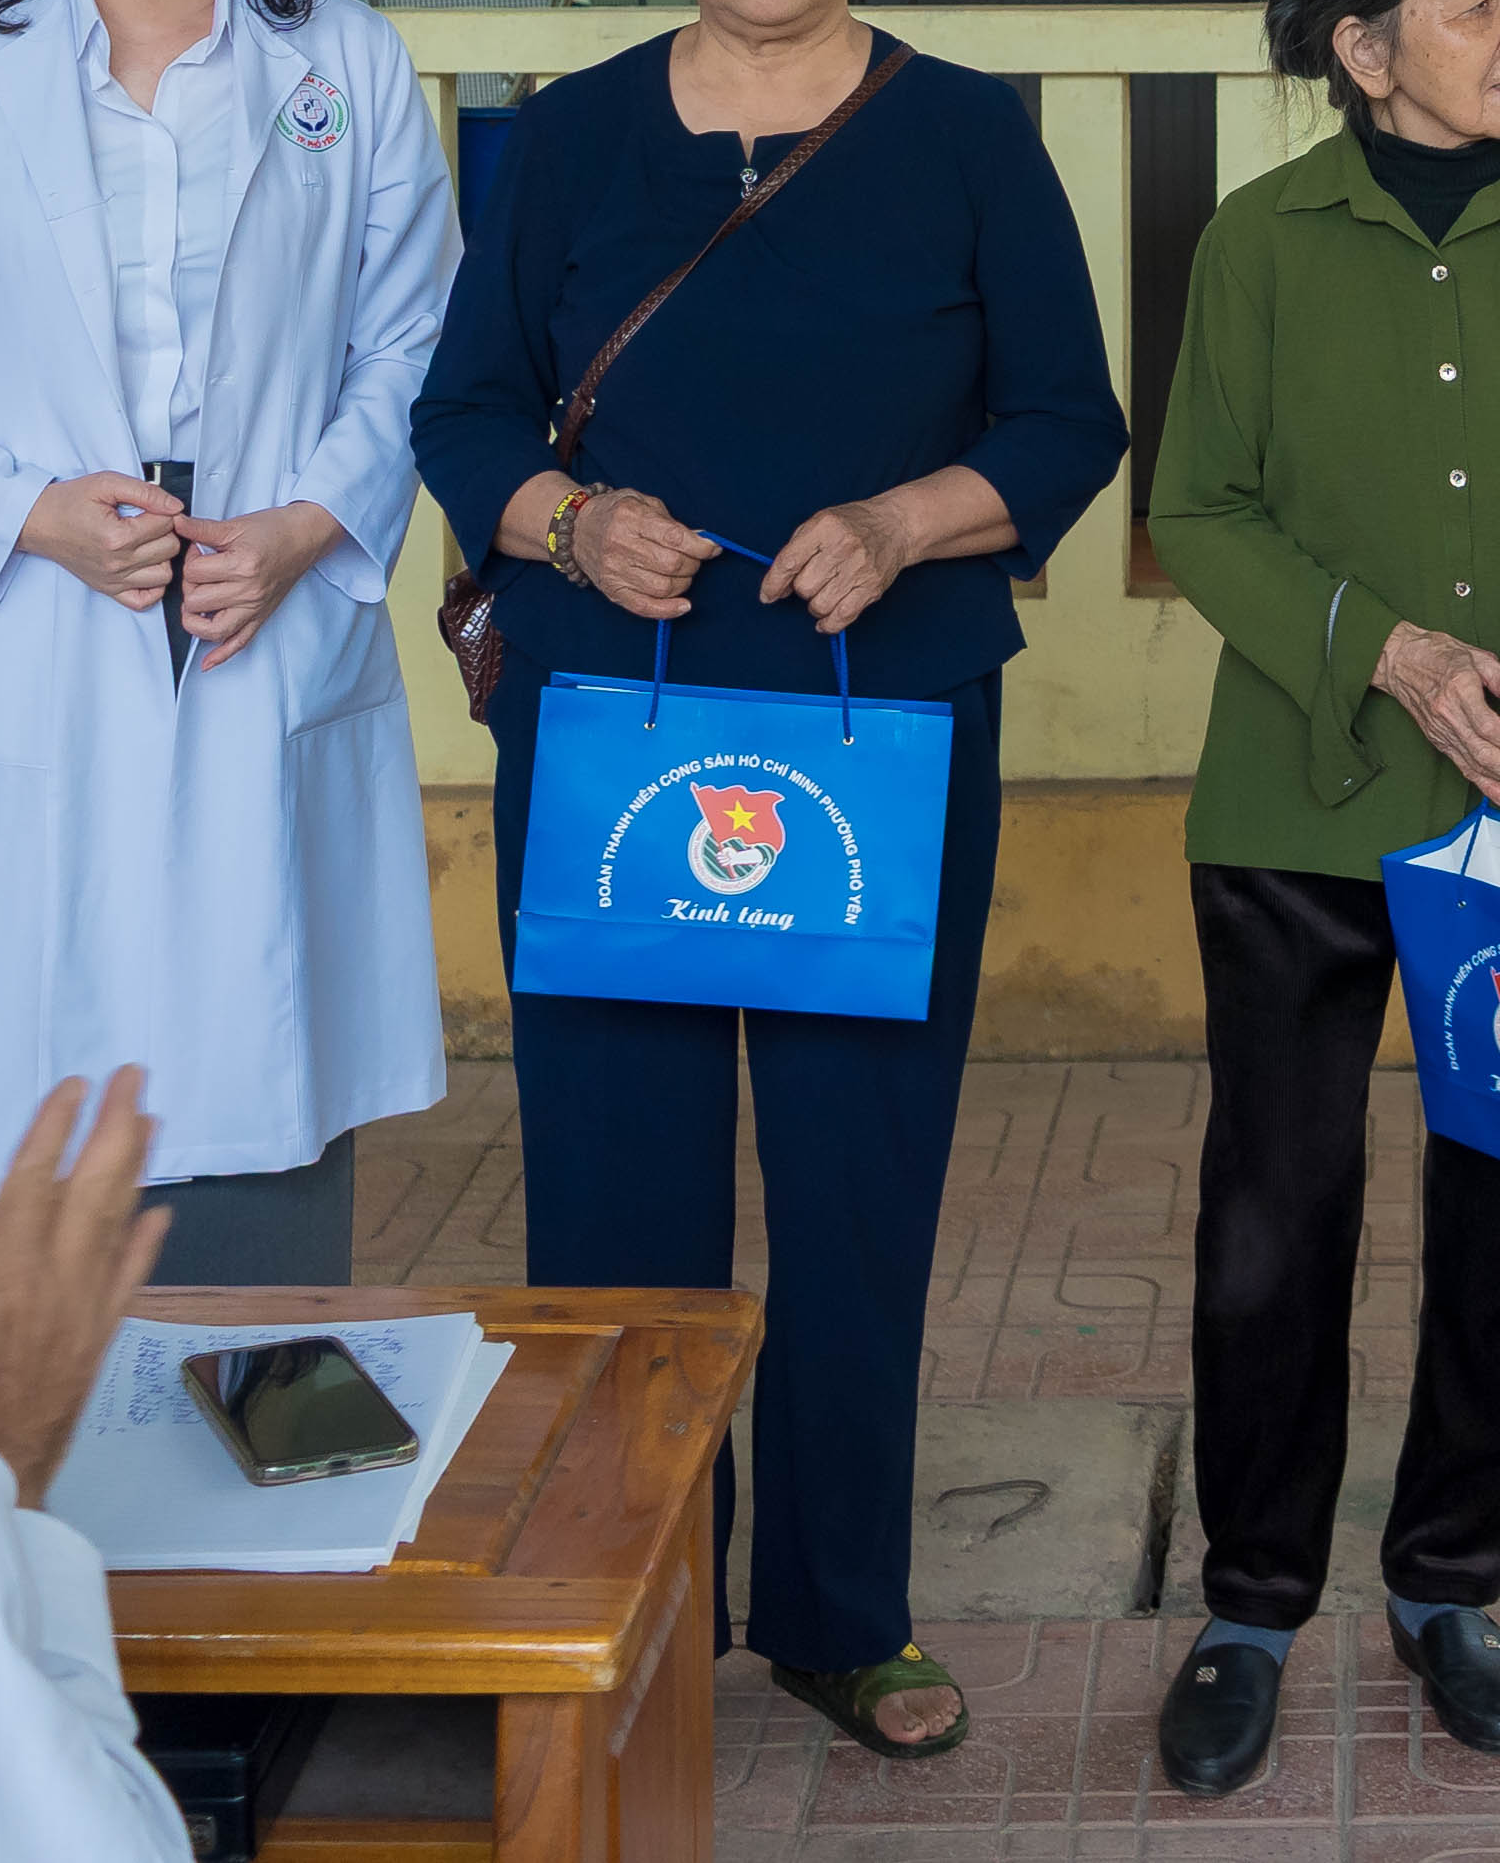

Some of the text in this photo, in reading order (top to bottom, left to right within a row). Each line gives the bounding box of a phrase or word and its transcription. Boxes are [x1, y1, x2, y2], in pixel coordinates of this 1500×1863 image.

[658, 761, 702, 788] CỘNG
[704, 753, 735, 769] SẢN
[763, 759, 789, 777] CHÍ
[630, 782, 661, 816] NIÊN
[788, 769, 823, 801] MINH
[603, 815, 634, 861] THANH
[819, 795, 858, 856] PHƯỜNG
[598, 864, 613, 908] ĐOÀN
[736, 902, 796, 931] tặng
[843, 893, 864, 925] YÊN
